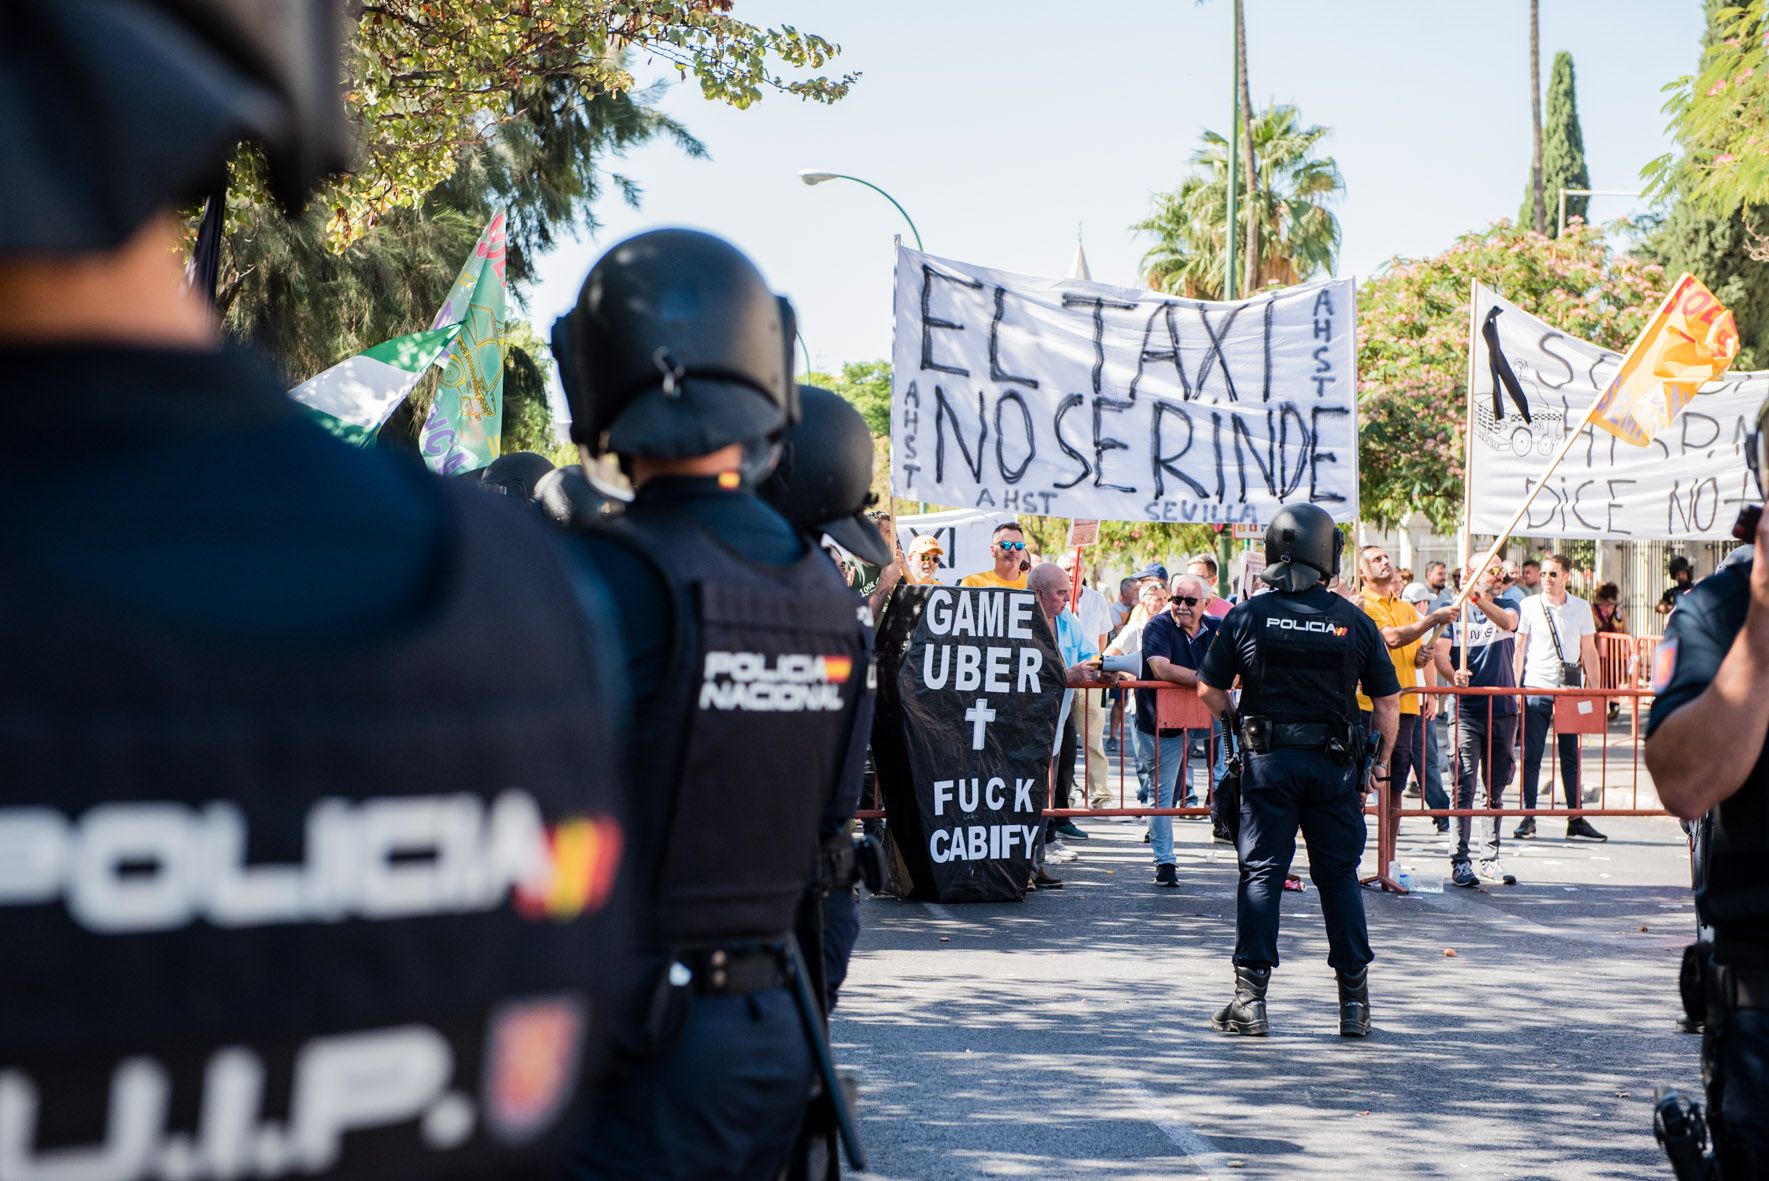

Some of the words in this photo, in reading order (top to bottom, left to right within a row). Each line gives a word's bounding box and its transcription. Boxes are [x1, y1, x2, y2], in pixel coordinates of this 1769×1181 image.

[920, 264, 1039, 389] EL
[1062, 290, 1277, 402] TAXI
[934, 385, 1036, 485] NO
[1053, 393, 1137, 494] SE
[1152, 398, 1351, 504] RINDE
[975, 488, 1059, 516] AHST
[1144, 502, 1258, 524] SEVILLA
[1525, 477, 1637, 535] DICE
[926, 589, 1036, 640] GAME
[1266, 617, 1337, 634] POLICIA
[704, 652, 827, 682] POLICIA
[922, 643, 1044, 695] UBER
[699, 681, 844, 711] NACIONAL
[933, 777, 1036, 816] FUCK
[929, 824, 1040, 864] CABIFY
